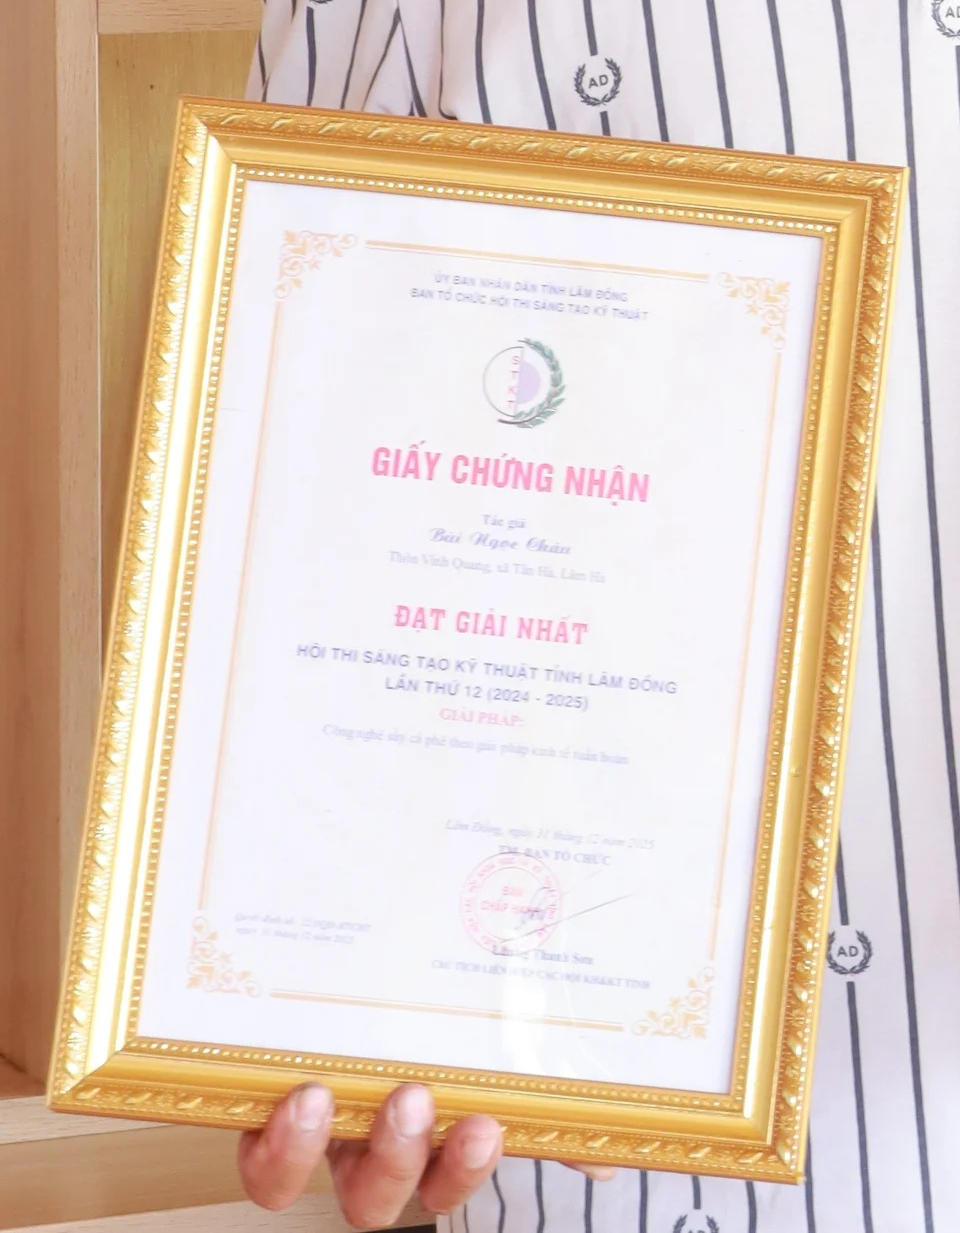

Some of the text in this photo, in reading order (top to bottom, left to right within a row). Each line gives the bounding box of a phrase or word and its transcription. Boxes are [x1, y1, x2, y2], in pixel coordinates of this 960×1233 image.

[588, 74, 609, 89] AD
[371, 441, 649, 505] GIẤY CHỨNG NHẬN
[394, 604, 588, 644] ĐẠT GIẢI NHẤT
[296, 642, 326, 659] HỘI
[330, 647, 358, 661] THI
[362, 649, 410, 667] SÁNG
[416, 655, 450, 672] TẠO
[454, 658, 477, 673] KỸ
[483, 662, 539, 681] THUẬT
[544, 665, 582, 684] TỈNH
[587, 671, 623, 688] LÂM
[424, 680, 460, 696] THỨ
[464, 685, 482, 698] 12
[486, 688, 529, 702] (2024
[545, 693, 588, 712] 2025)
[837, 945, 859, 957] AD
